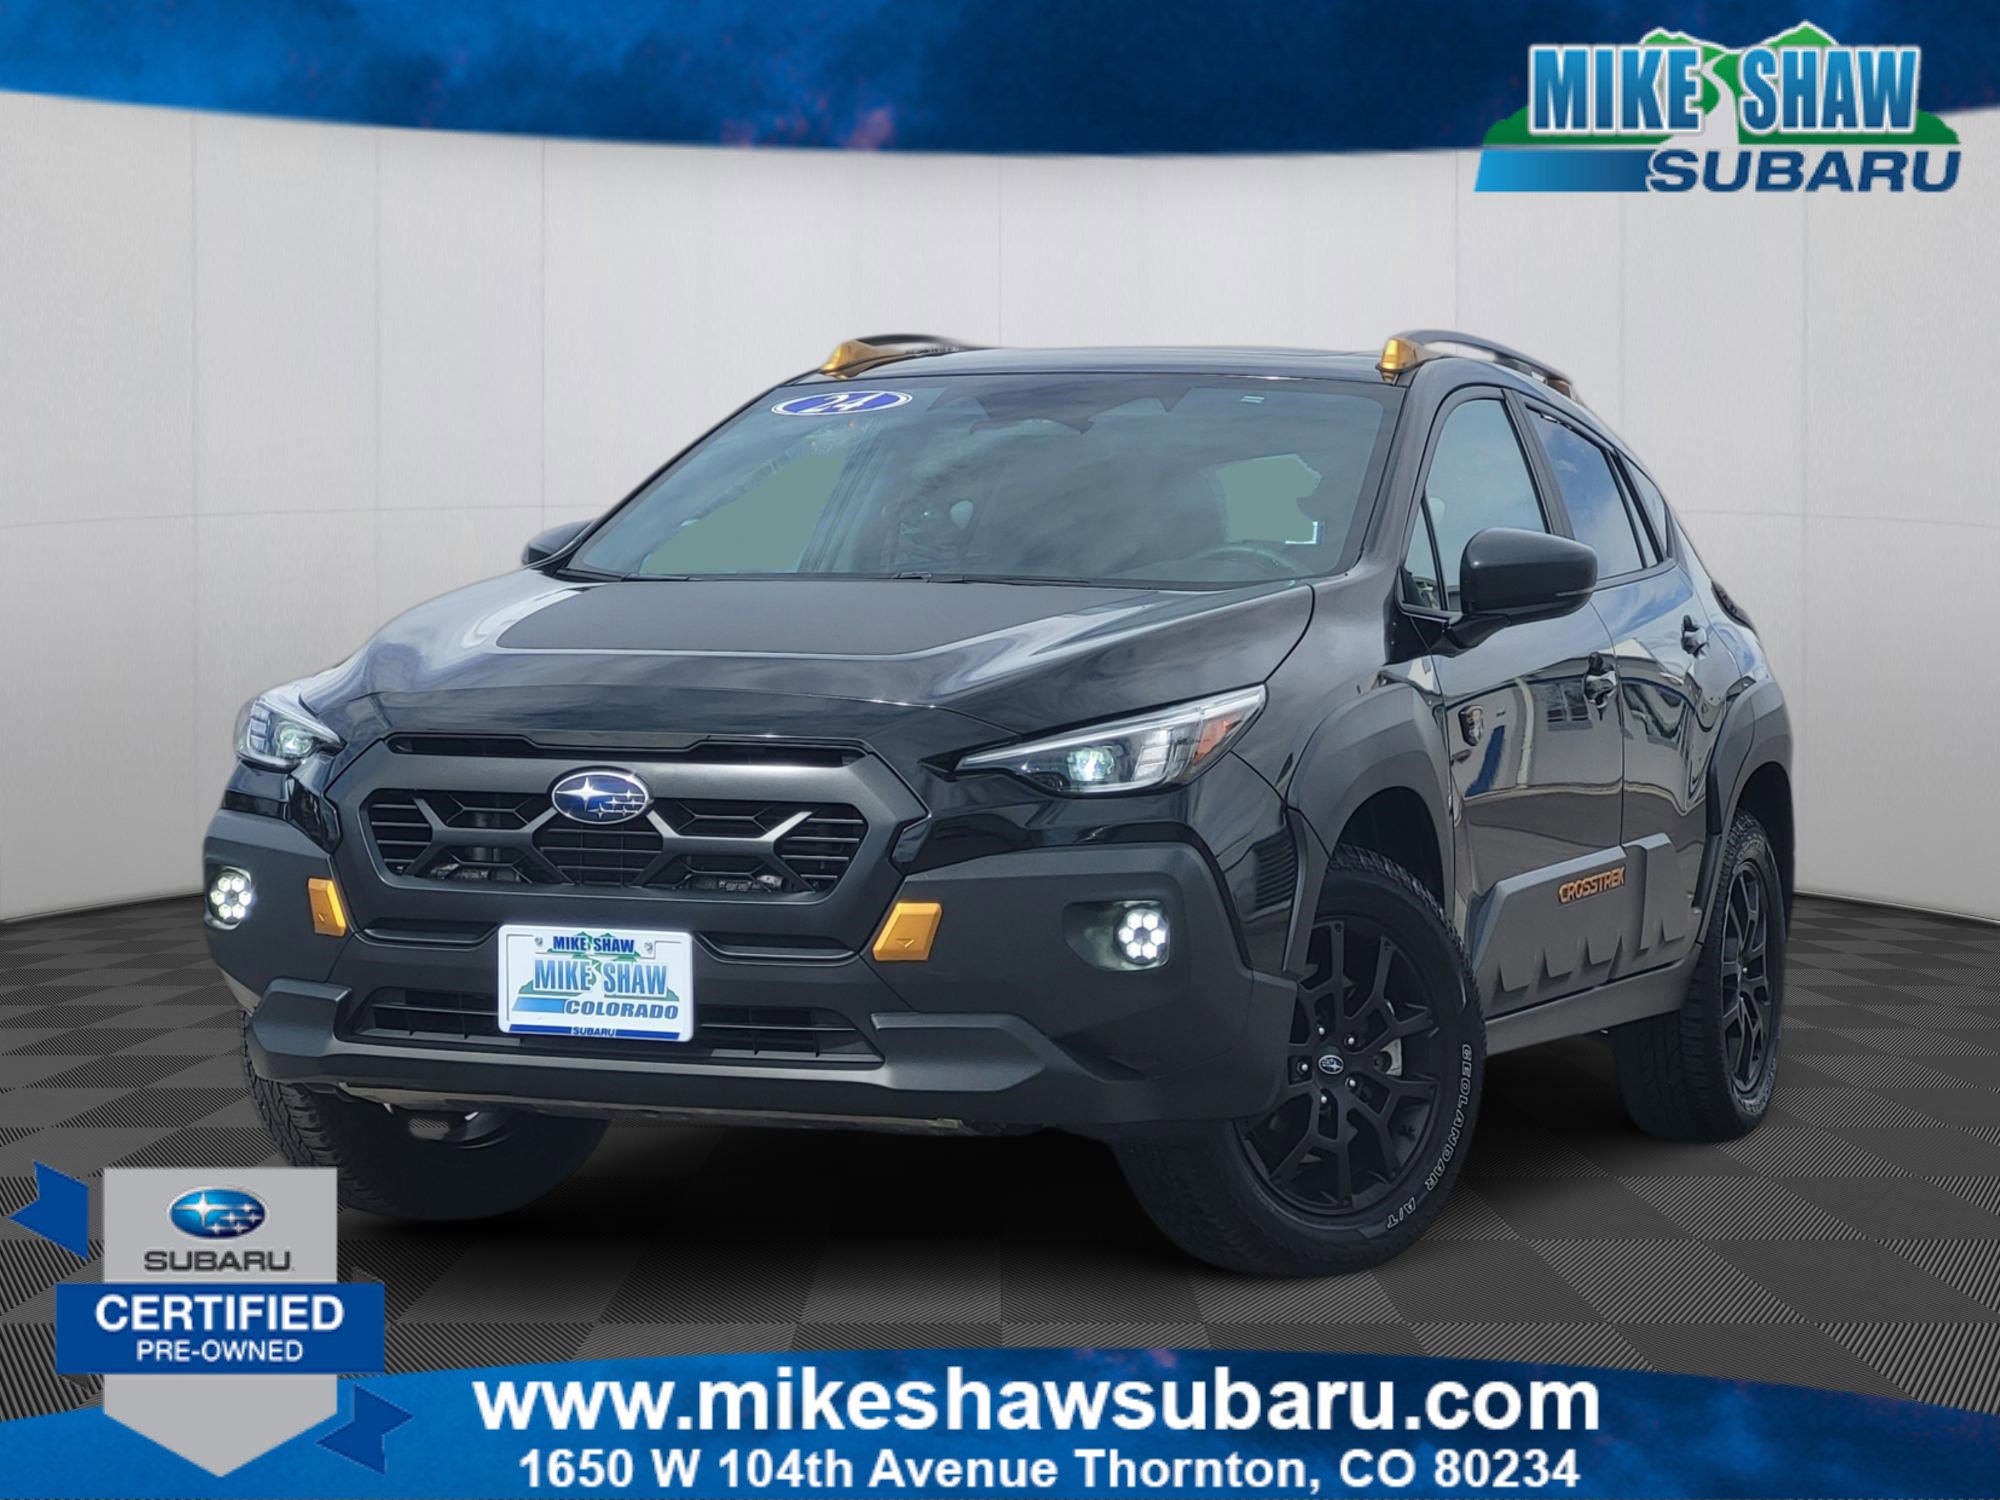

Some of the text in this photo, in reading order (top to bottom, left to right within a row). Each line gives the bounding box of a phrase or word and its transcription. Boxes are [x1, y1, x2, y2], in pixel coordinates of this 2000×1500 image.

[798, 391, 887, 413] 24
[1559, 866, 1625, 904] CROSSTREK
[553, 936, 635, 953] MIKE SHAW
[534, 959, 668, 995] MIKE SHAW
[565, 1000, 679, 1020] COLORADO
[572, 1026, 616, 1037] SUBARU
[1424, 1043, 1472, 1191] GEOLANDAR
